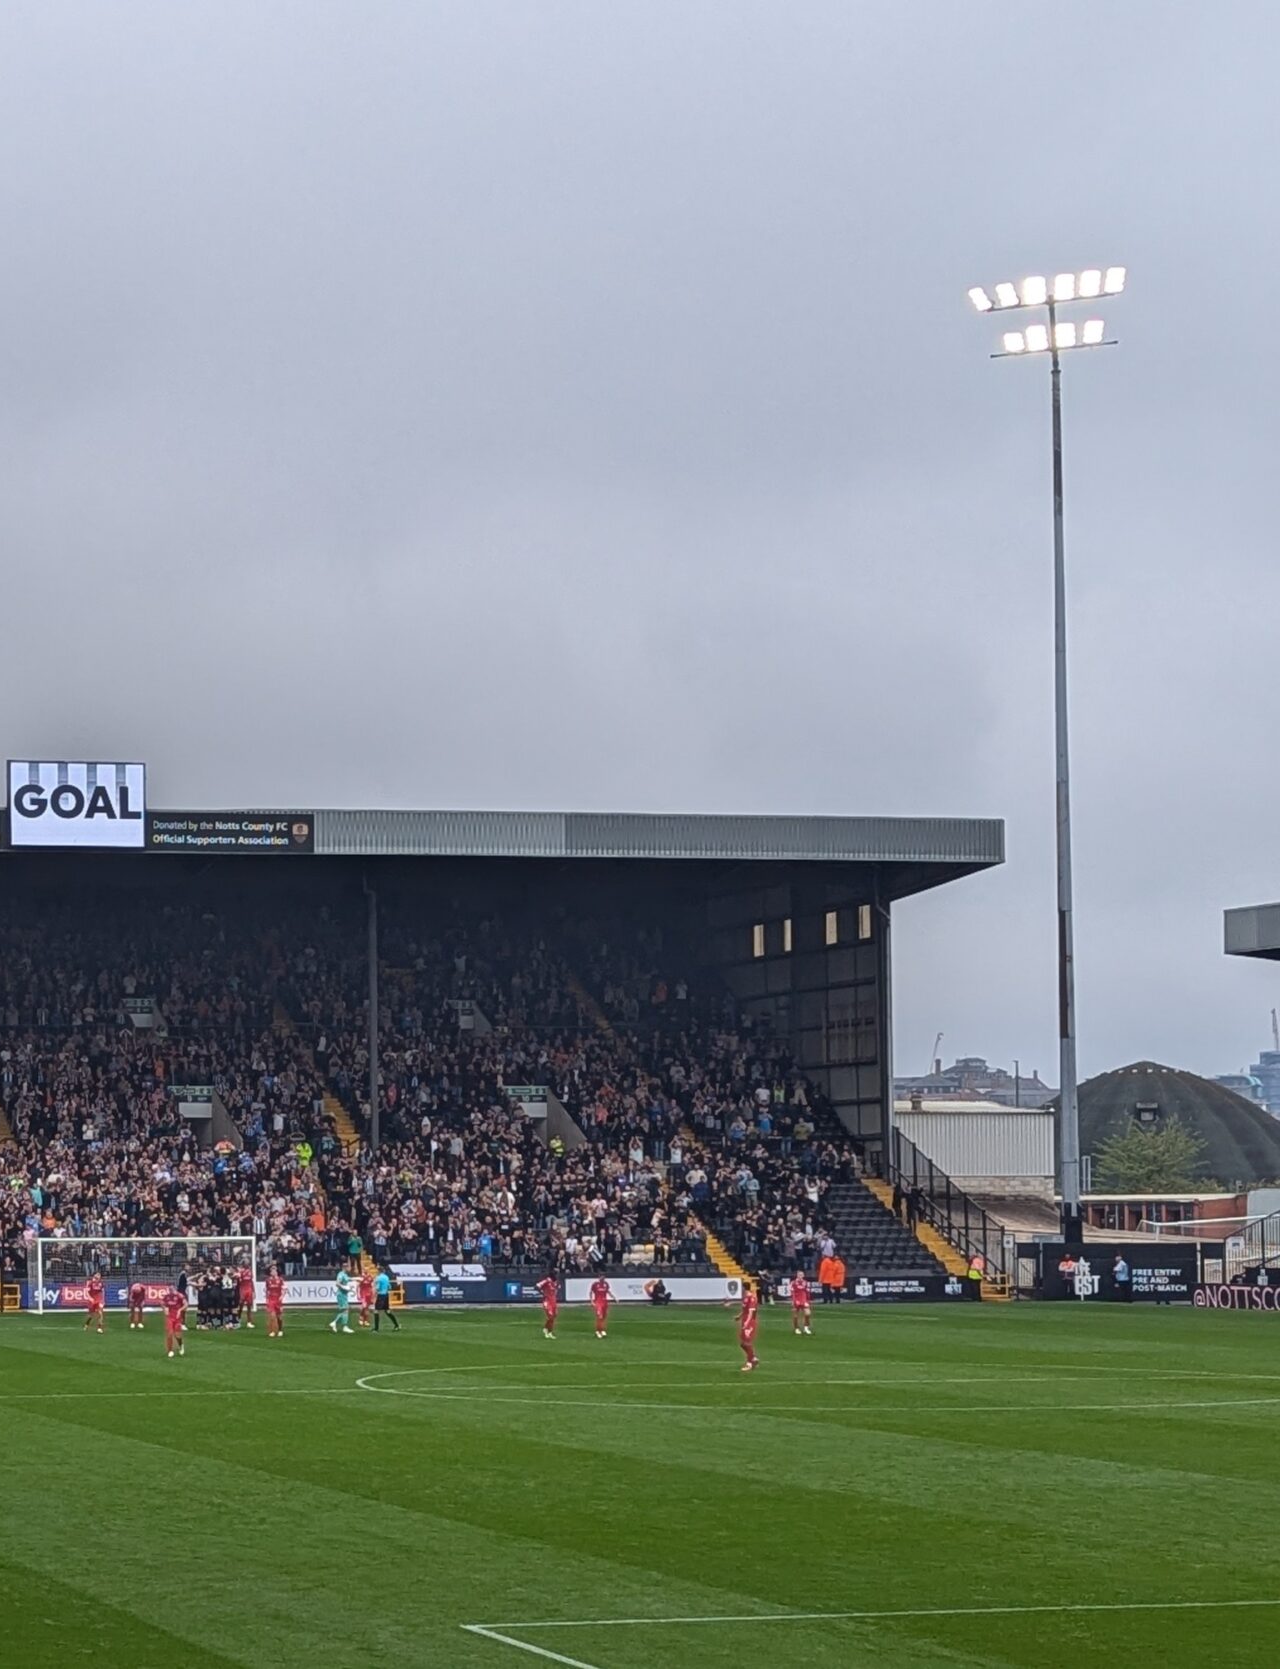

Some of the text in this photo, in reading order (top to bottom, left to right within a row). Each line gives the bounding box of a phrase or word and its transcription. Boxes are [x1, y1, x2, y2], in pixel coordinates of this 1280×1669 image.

[14, 784, 142, 820] GOAL
[153, 820, 288, 832] Donated by the Notts County FC
[153, 835, 289, 846] Official Supporters Association
[34, 1287, 90, 1304] sky bet
[307, 1286, 356, 1298] HOMS
